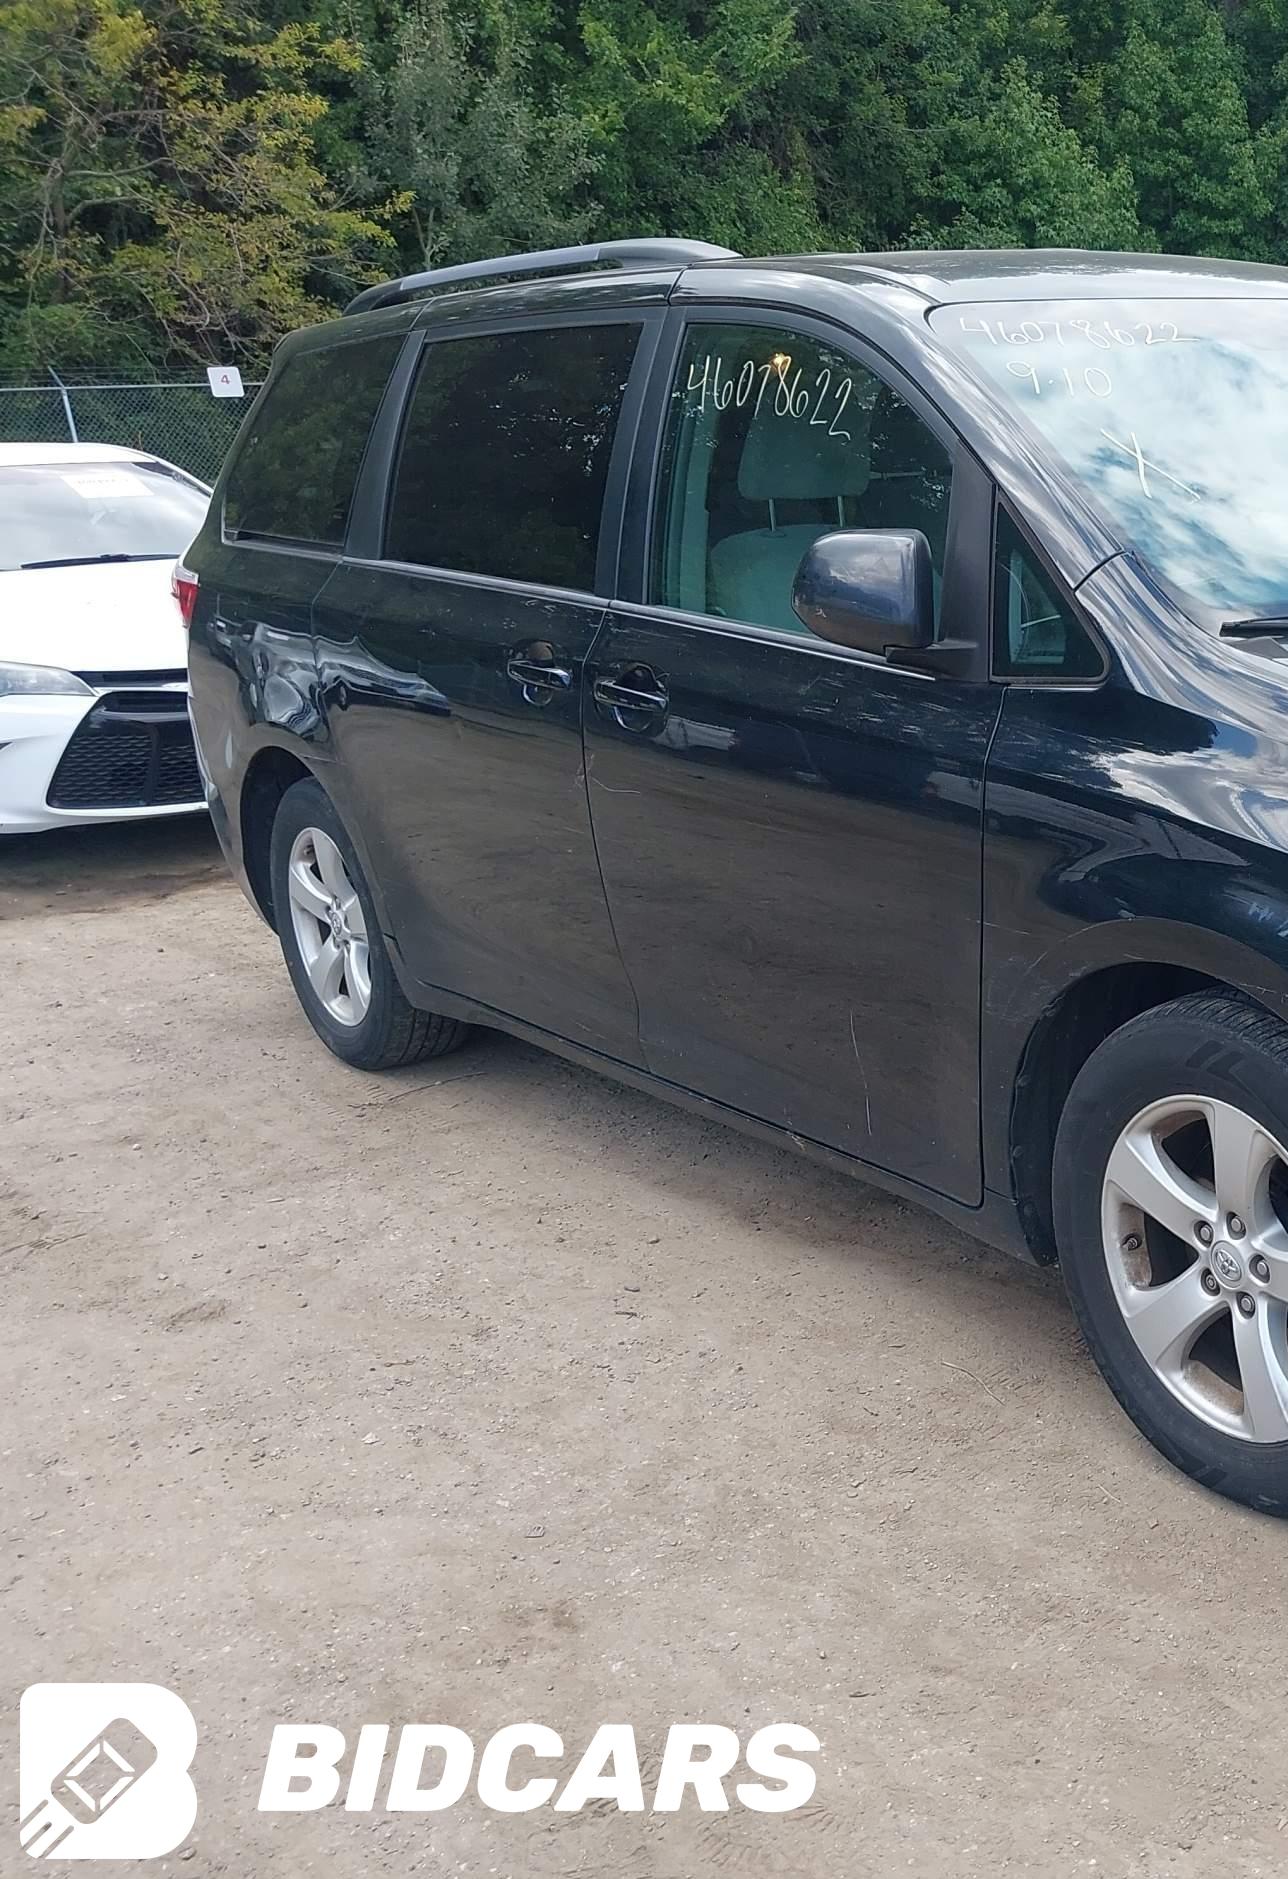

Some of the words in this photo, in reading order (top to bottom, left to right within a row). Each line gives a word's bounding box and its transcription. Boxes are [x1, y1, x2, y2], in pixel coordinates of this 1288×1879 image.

[959, 315, 1201, 349] 46078622
[220, 374, 231, 386] 4
[687, 353, 852, 440] 46078622
